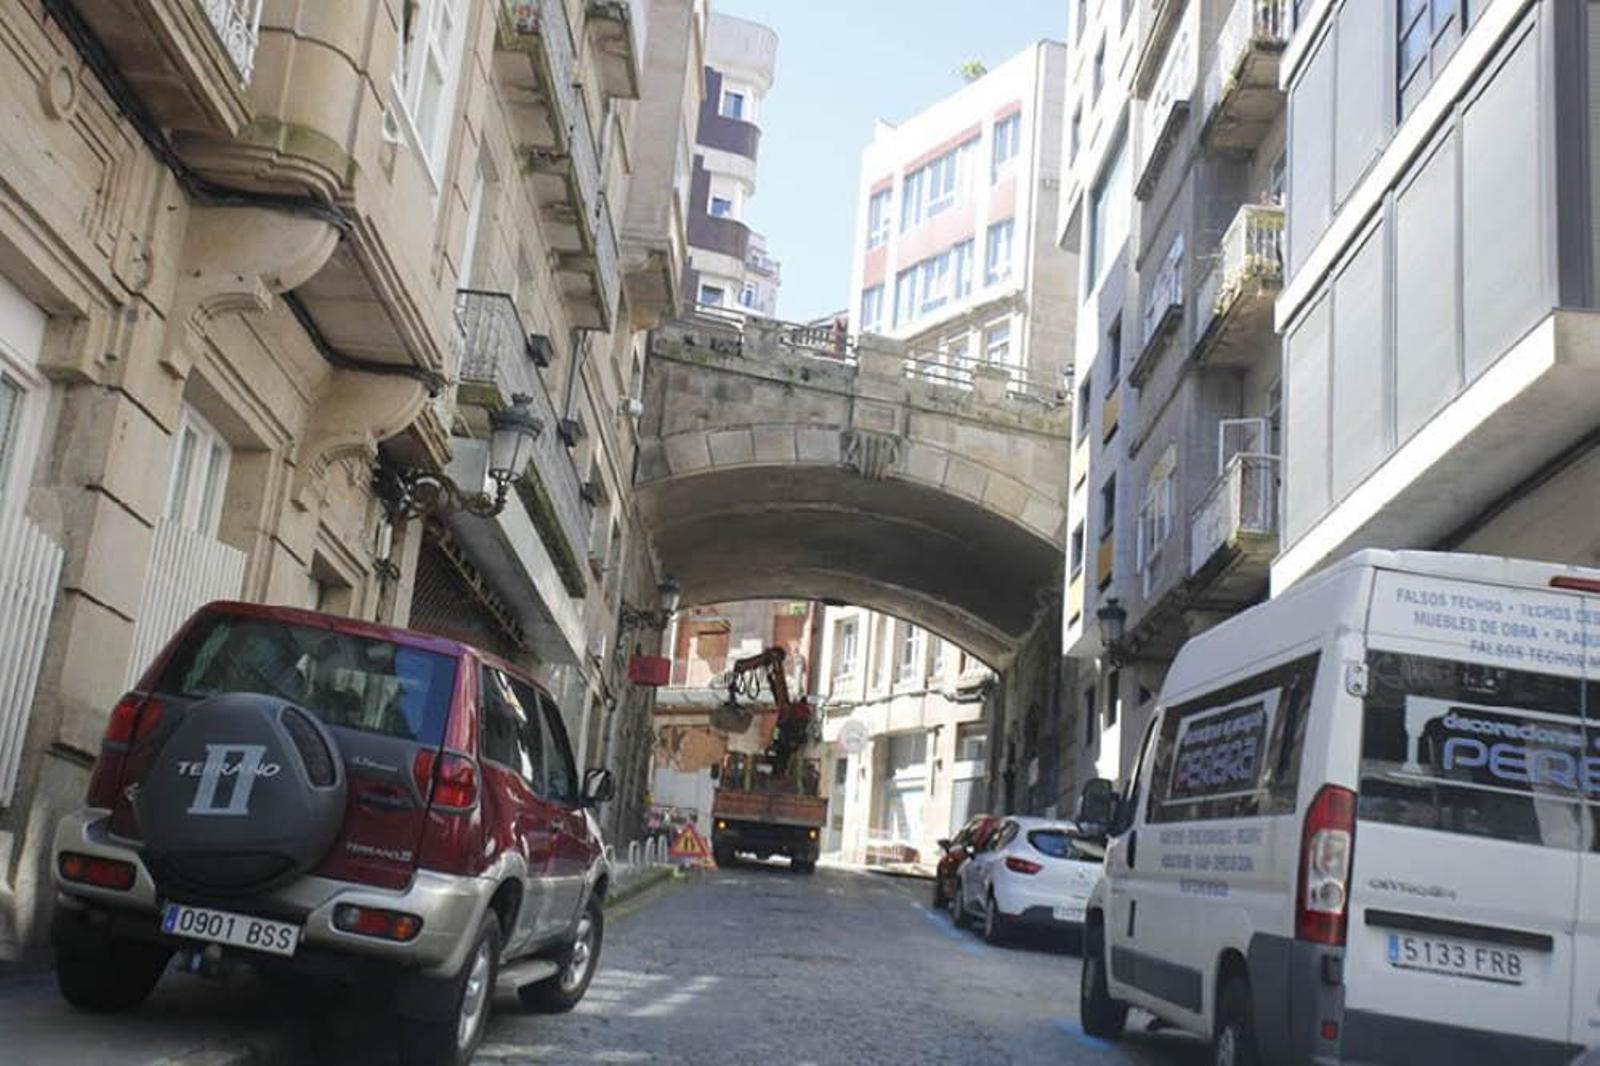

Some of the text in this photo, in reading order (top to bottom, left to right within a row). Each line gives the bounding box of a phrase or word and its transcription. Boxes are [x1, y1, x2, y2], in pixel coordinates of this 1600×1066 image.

[1396, 588, 1448, 606] FALSOS
[1451, 595, 1503, 614] TECHOS
[1520, 603, 1571, 622] TECHOS
[1413, 611, 1476, 633] MUEBLES
[1480, 619, 1498, 635] DE
[1501, 622, 1538, 640] OBRA
[1469, 640, 1523, 660] FALSOS
[180, 908, 293, 950] 0901 BSS
[1403, 938, 1522, 977] 5133 FRB
